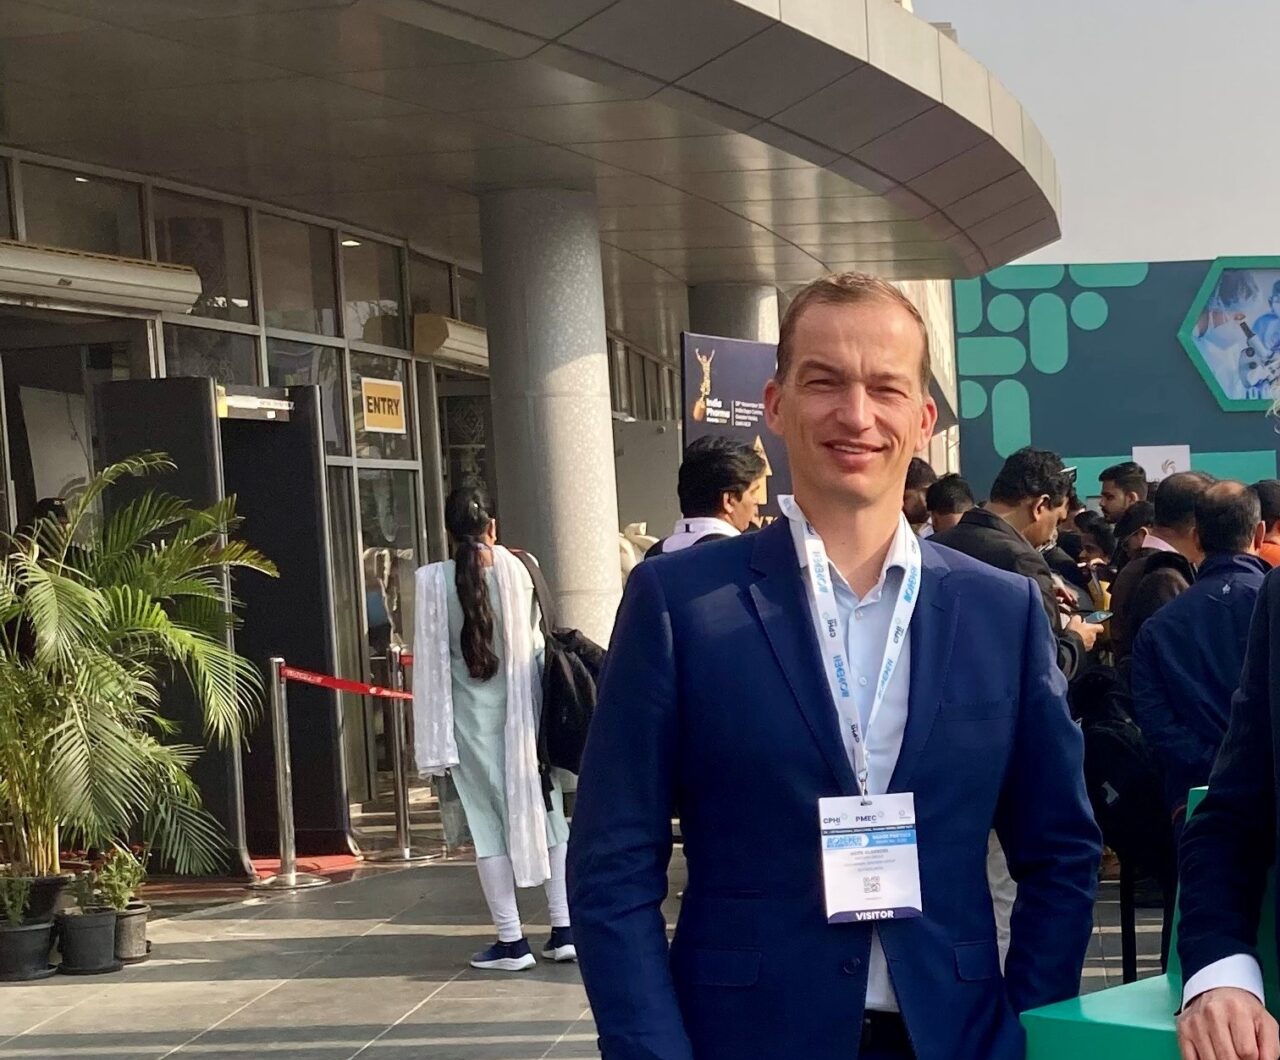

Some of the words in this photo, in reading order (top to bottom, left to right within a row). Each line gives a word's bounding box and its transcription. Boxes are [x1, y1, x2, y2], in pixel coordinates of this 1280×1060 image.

[366, 396, 400, 416] ENTRY
[823, 817, 841, 825] CPHI
[855, 815, 877, 823] PMEC
[855, 909, 895, 921] VISITOR
